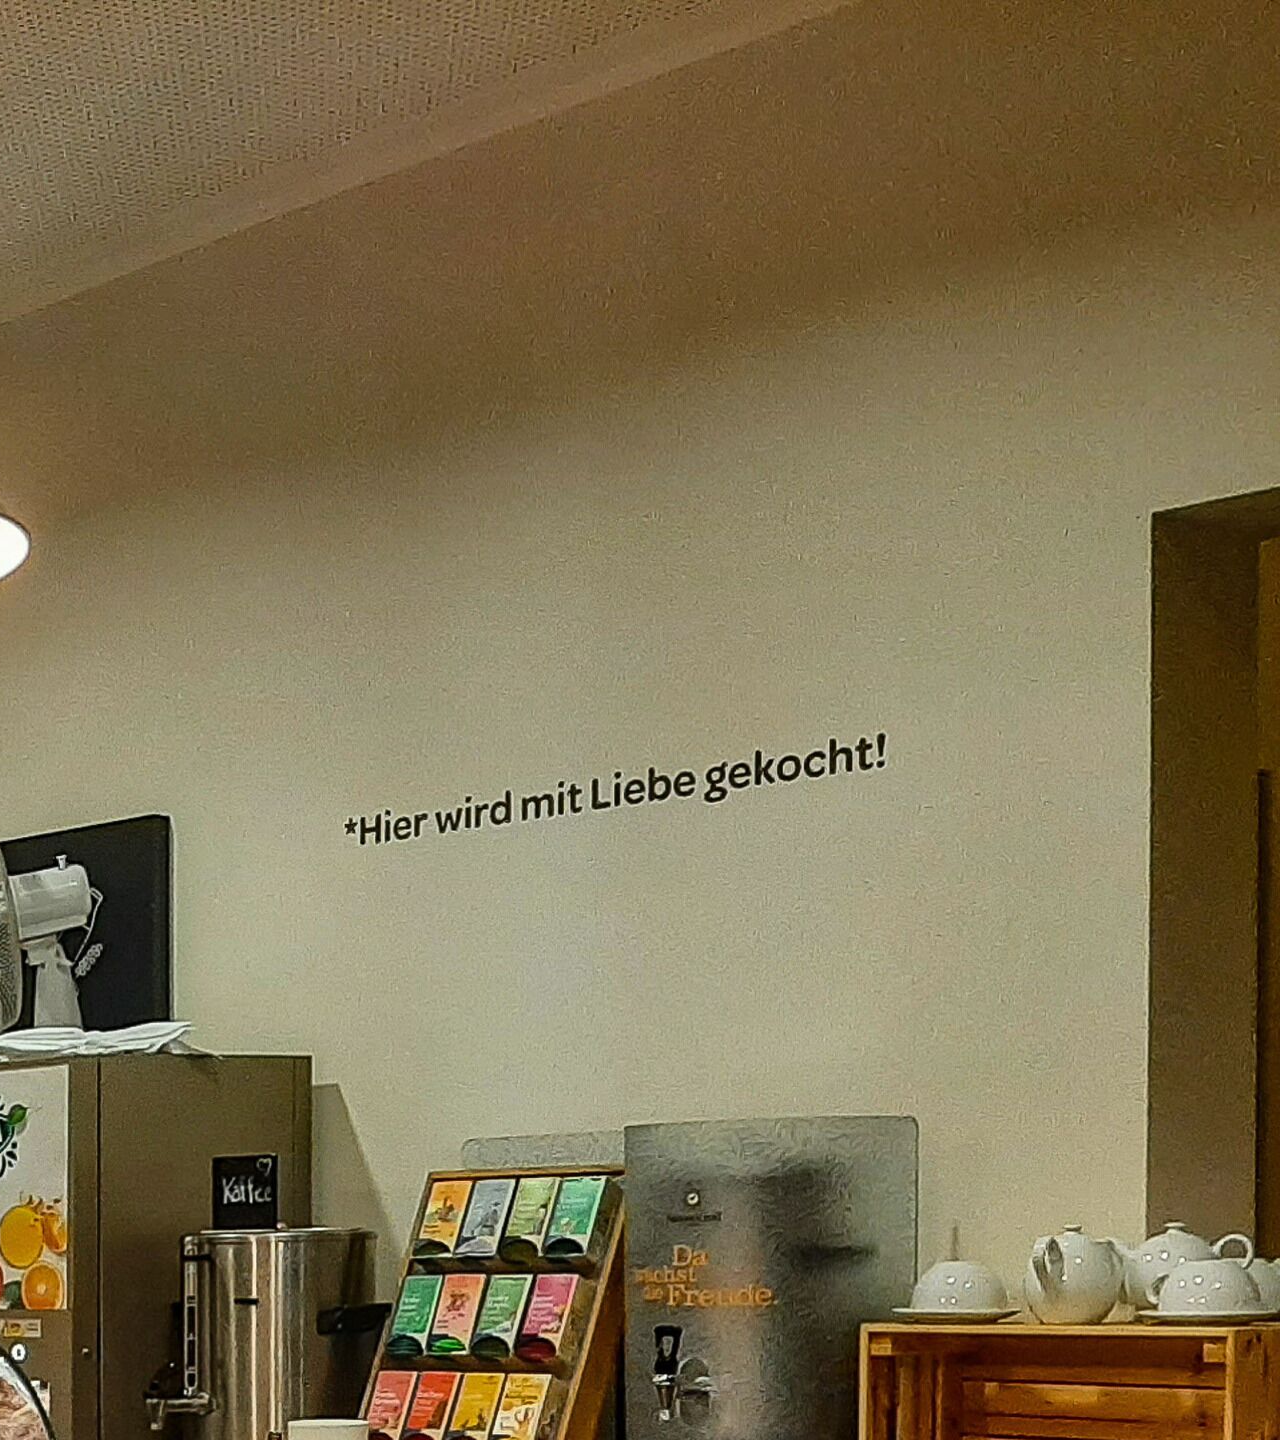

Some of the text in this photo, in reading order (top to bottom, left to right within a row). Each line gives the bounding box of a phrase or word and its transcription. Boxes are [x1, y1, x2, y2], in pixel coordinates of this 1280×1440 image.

[435, 790, 512, 834] wird
[520, 780, 583, 822] mit
[590, 766, 697, 811] Liebe
[703, 732, 887, 803] gekocht!
[672, 1243, 709, 1267] Da
